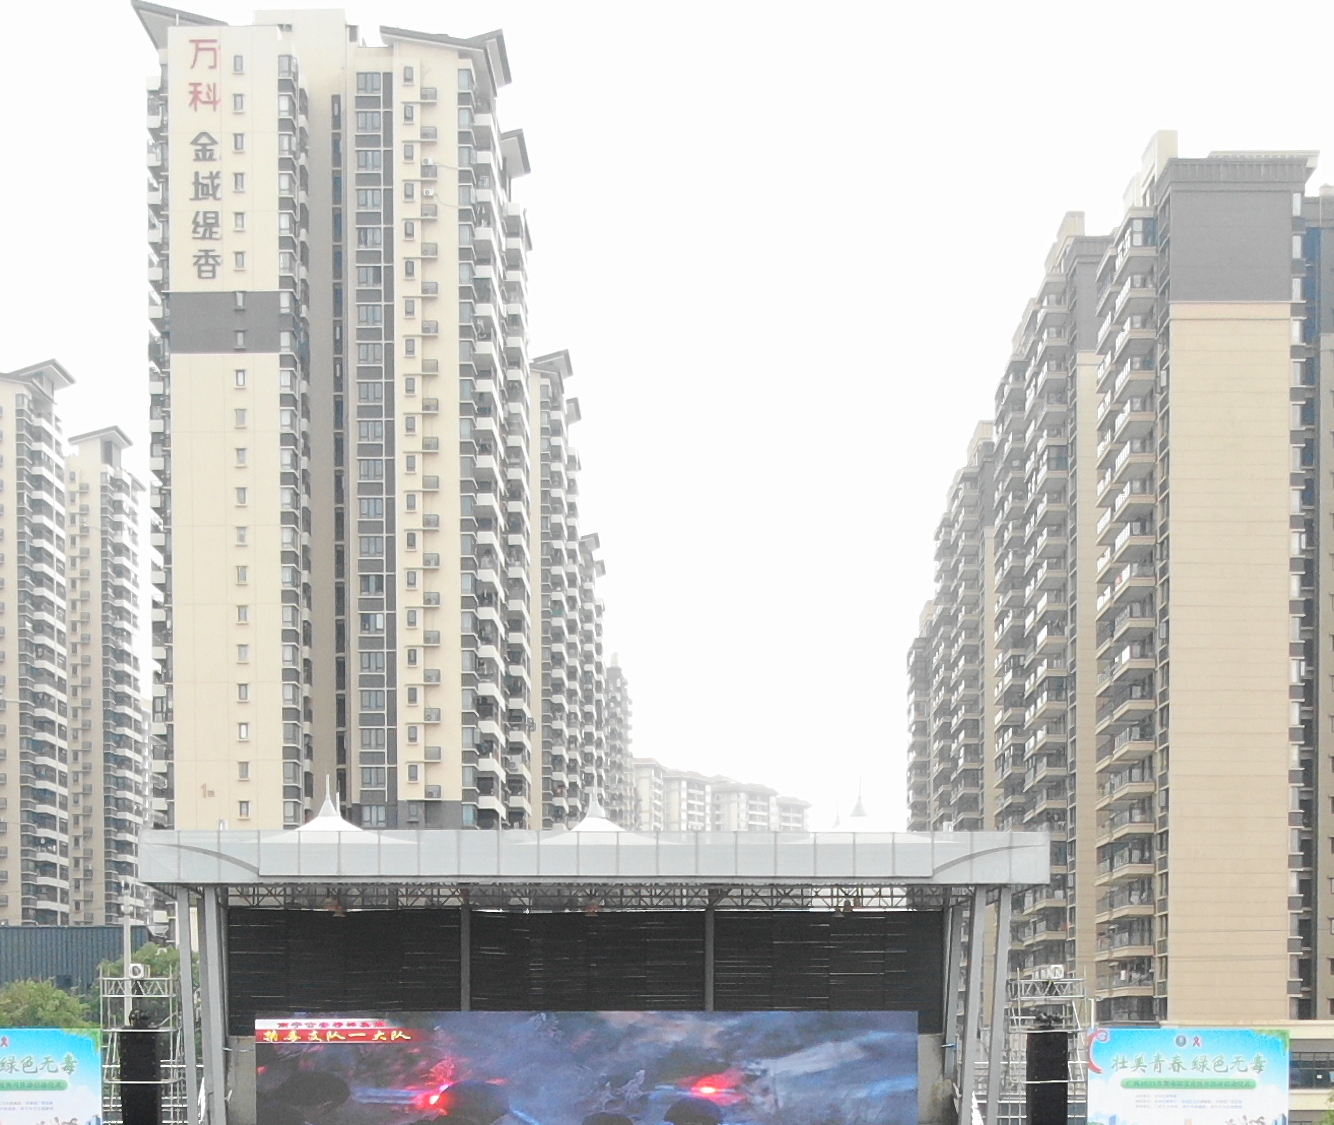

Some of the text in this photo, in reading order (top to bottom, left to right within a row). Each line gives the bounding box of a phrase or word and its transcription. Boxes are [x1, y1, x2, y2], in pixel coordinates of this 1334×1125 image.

[188, 38, 221, 280] 万科 金域缇香
[1111, 1051, 1267, 1074] 壮美青春 绿色无毒
